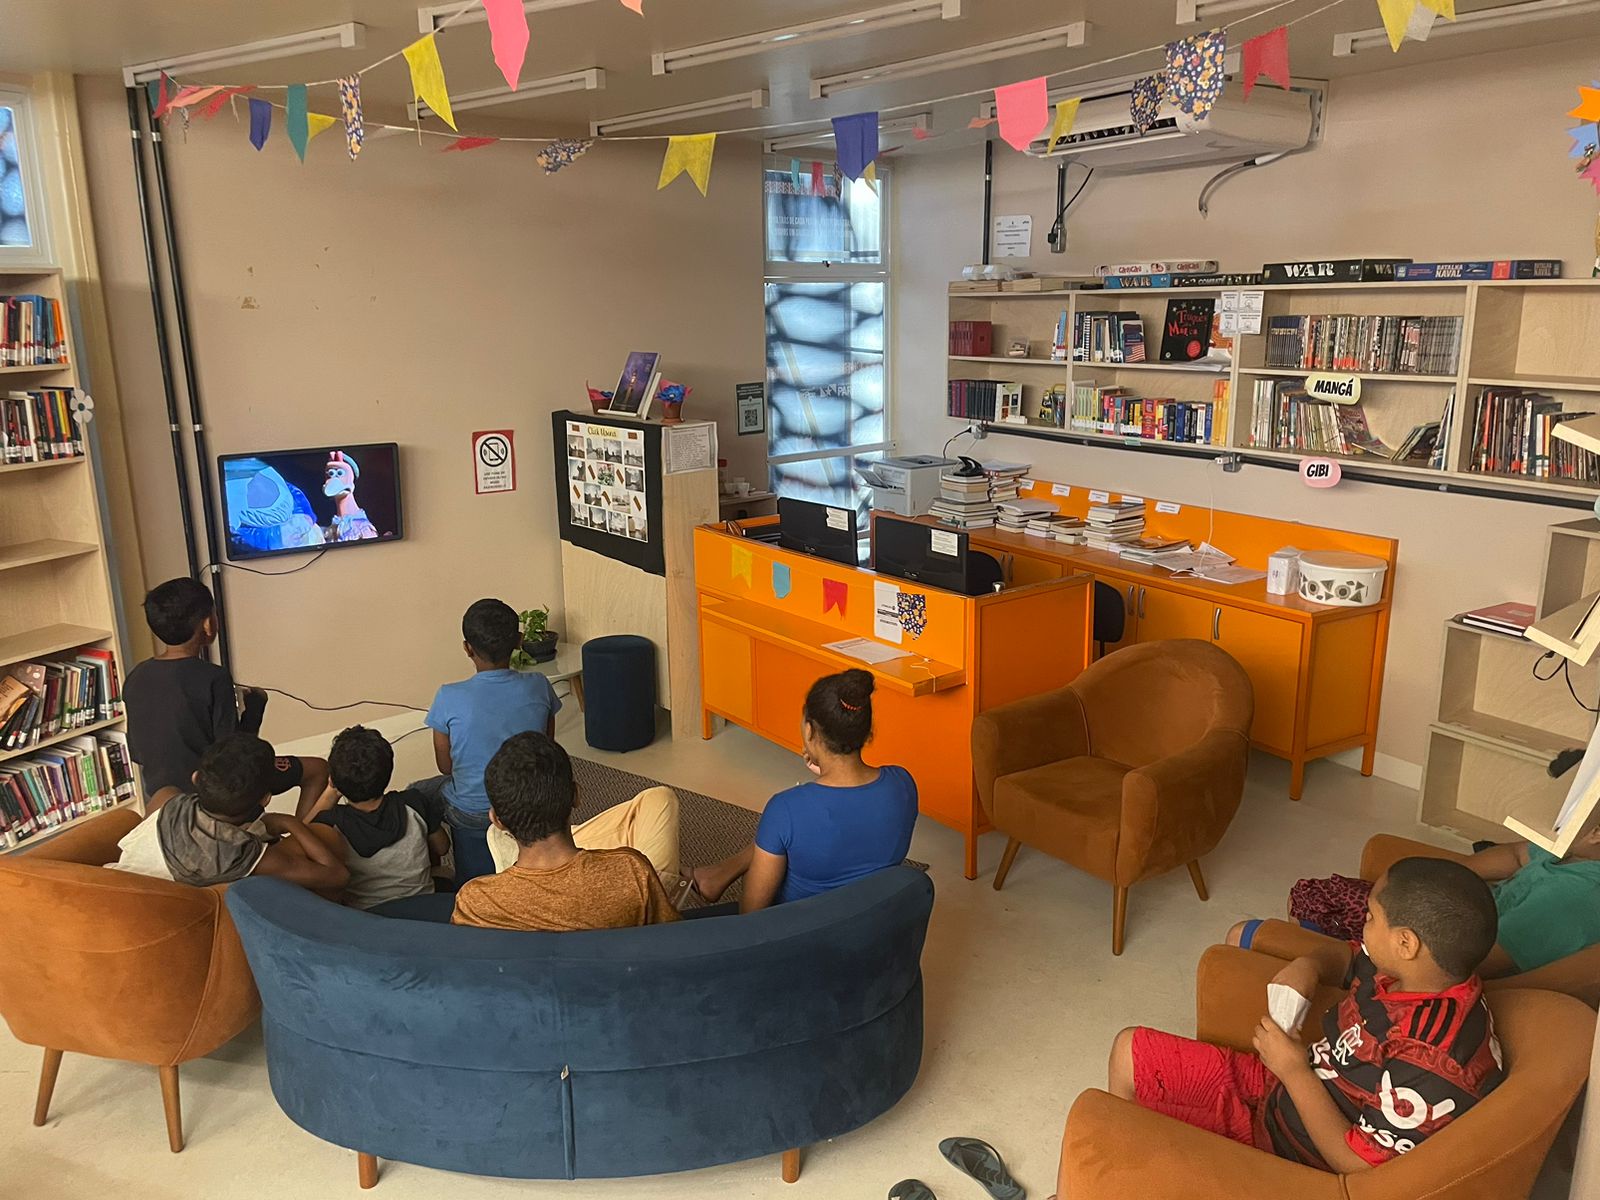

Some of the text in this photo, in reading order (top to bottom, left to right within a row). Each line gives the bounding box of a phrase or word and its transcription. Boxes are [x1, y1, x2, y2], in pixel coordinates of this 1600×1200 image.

[1284, 263, 1335, 278] WAR
[1435, 269, 1462, 278] NAVAL
[1119, 277, 1152, 287] WAR
[1314, 378, 1354, 396] MANGÁ
[1306, 464, 1330, 477] GIBI
